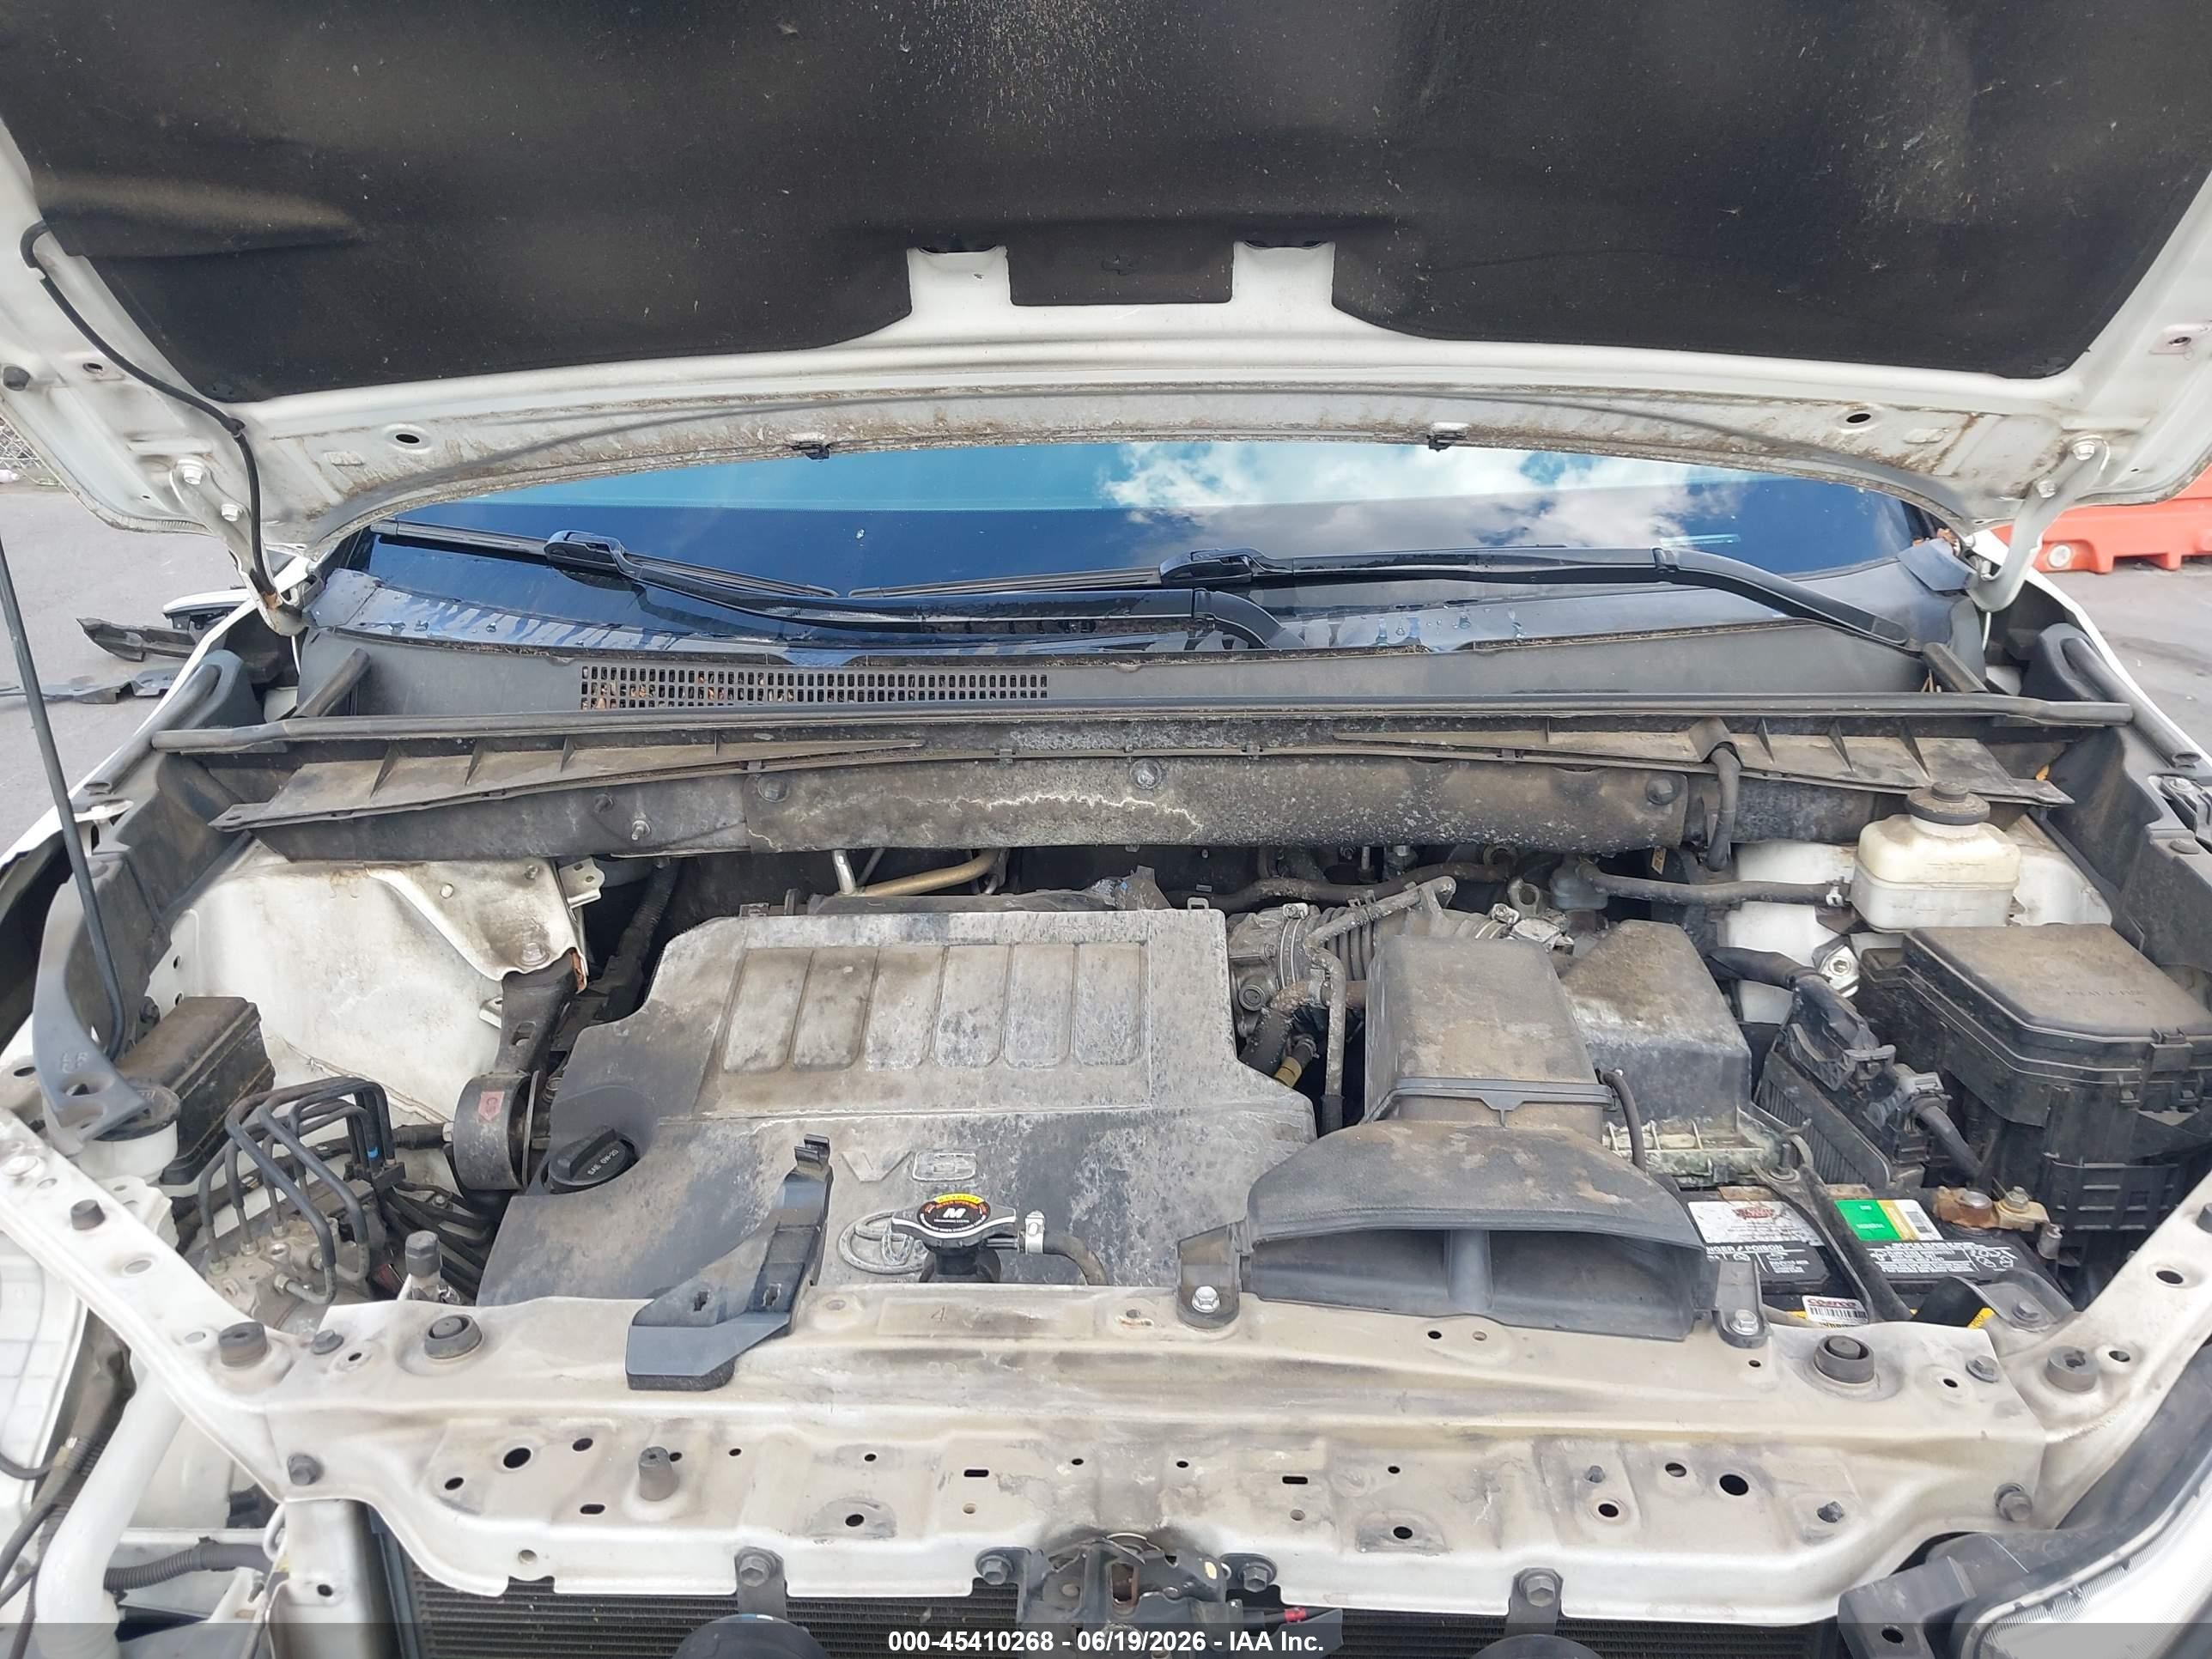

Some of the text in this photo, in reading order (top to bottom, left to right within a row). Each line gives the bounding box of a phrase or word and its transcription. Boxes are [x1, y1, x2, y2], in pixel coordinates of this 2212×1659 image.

[587, 1164, 602, 1175] SAE
[943, 1207, 967, 1218] M
[1705, 1245, 1735, 1254] NGER
